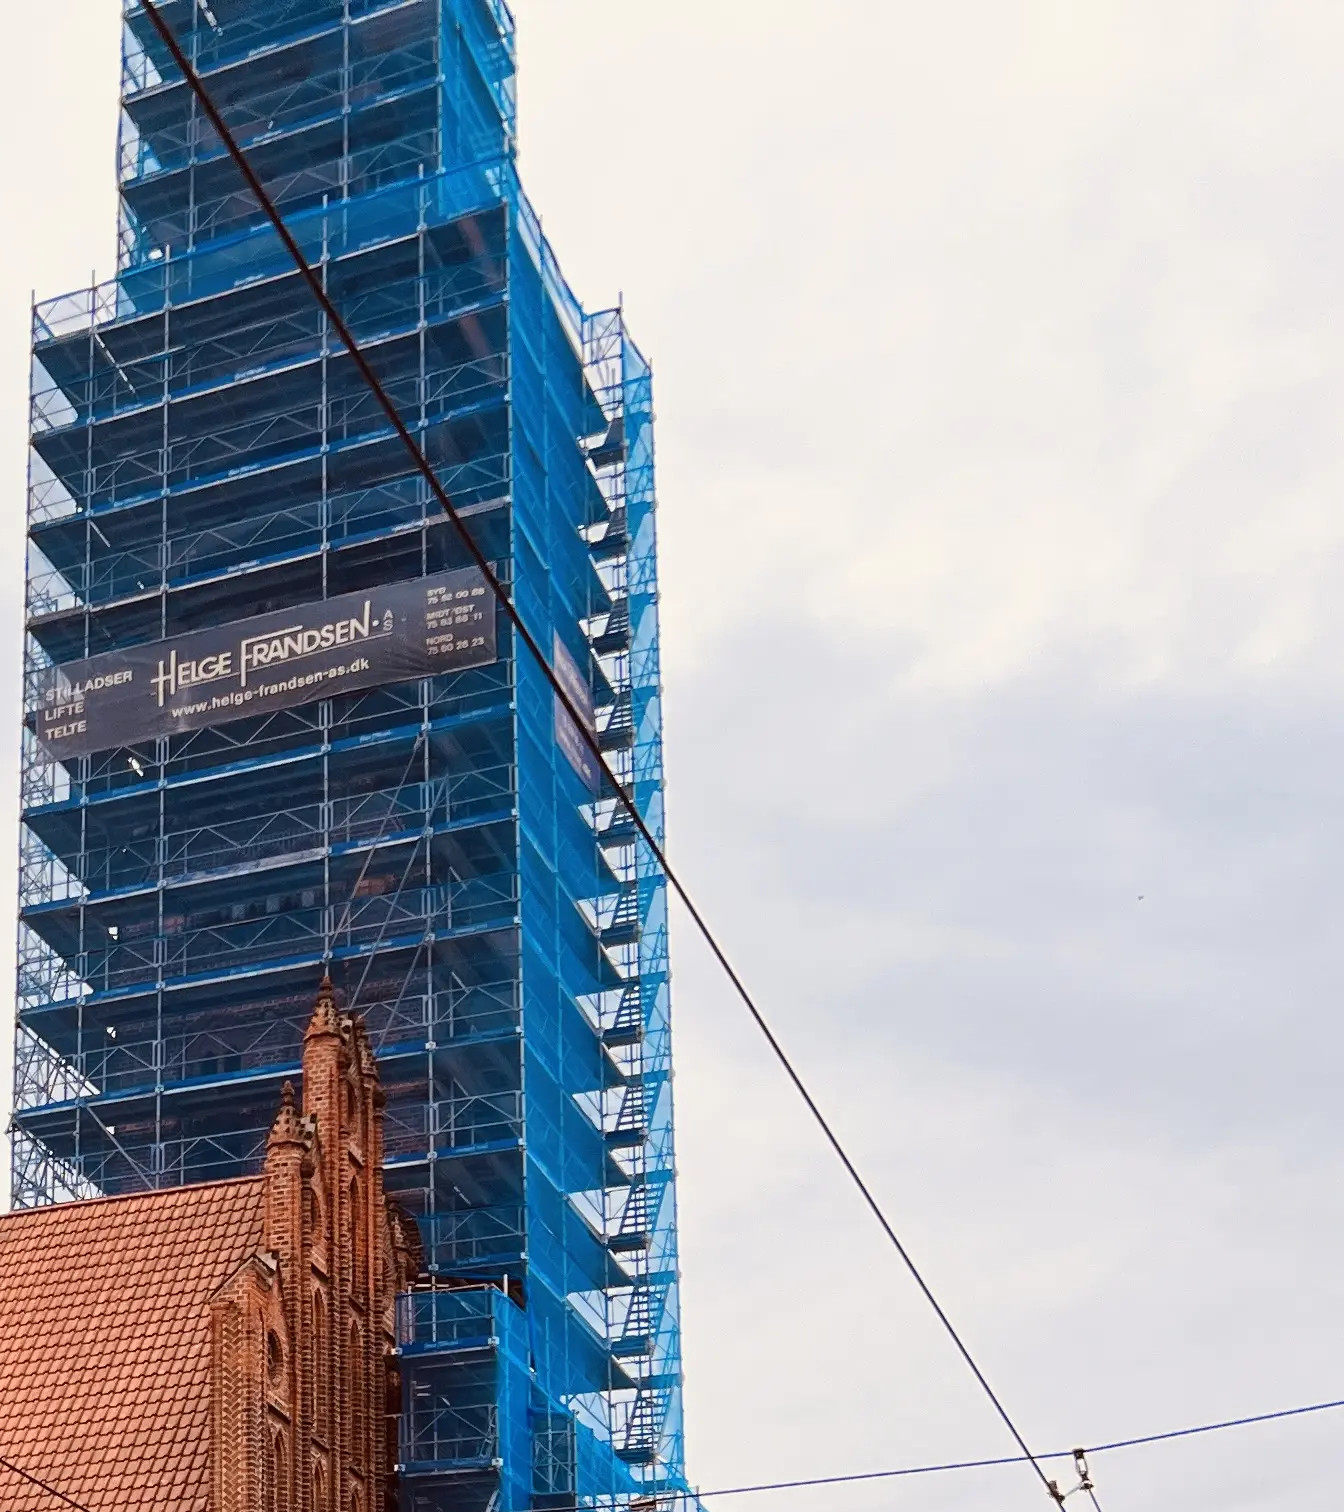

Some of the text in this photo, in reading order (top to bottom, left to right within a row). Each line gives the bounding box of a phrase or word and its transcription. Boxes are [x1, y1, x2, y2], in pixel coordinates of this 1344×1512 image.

[426, 634, 454, 645] NORD
[150, 600, 371, 707] HELGE FRANDSEN
[45, 670, 133, 702] STILLADSER
[172, 657, 370, 719] www.helge-frandsen-as.dk
[44, 701, 85, 722] LIFTE
[44, 719, 88, 741] TELTE
